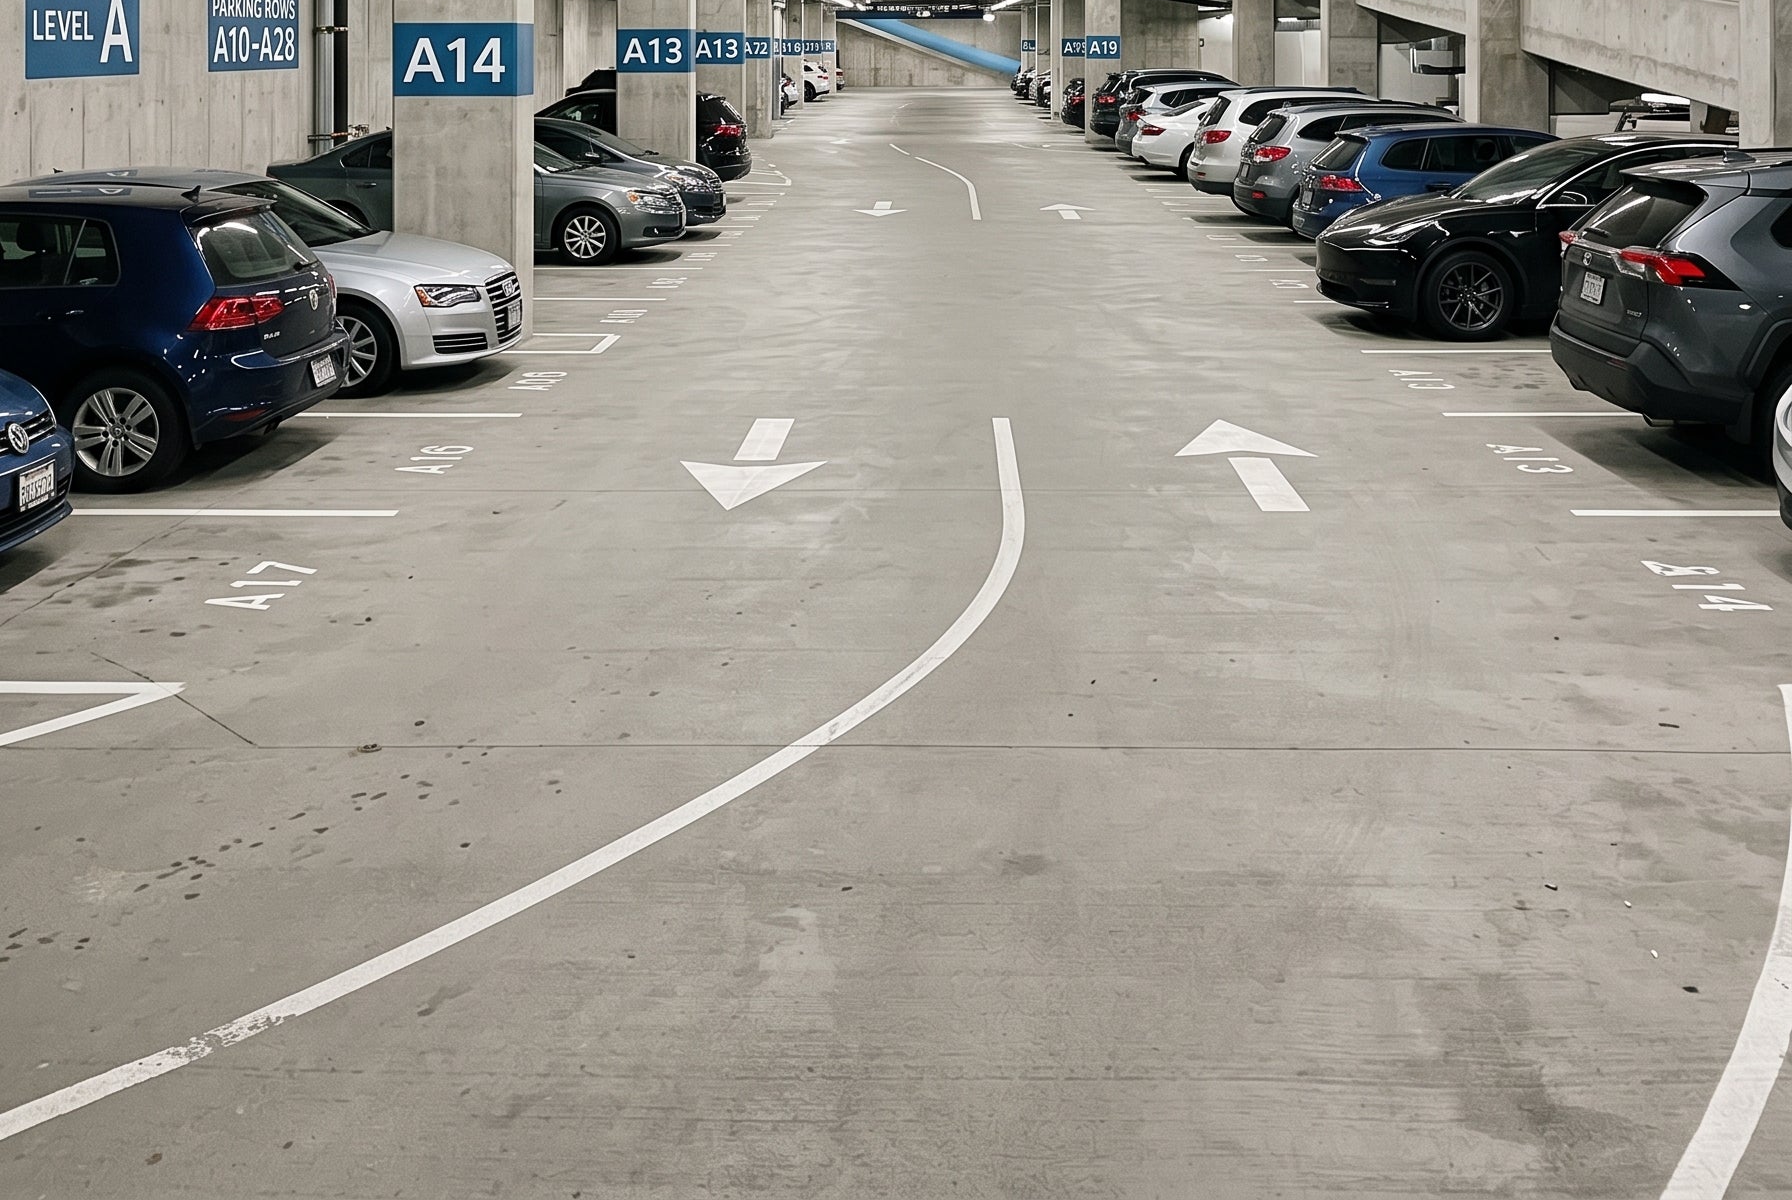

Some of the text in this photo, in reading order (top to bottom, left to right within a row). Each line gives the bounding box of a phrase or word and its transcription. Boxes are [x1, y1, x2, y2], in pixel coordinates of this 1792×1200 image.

[33, 10, 94, 41] LEVEL
[213, 26, 295, 63] A10-A28
[622, 37, 683, 64] A13
[695, 38, 738, 59] A13
[744, 42, 768, 55] A72
[1089, 40, 1118, 55] A19
[403, 37, 506, 83] A14
[394, 445, 474, 475] A16
[1486, 443, 1574, 474] A13
[204, 560, 318, 611] A17
